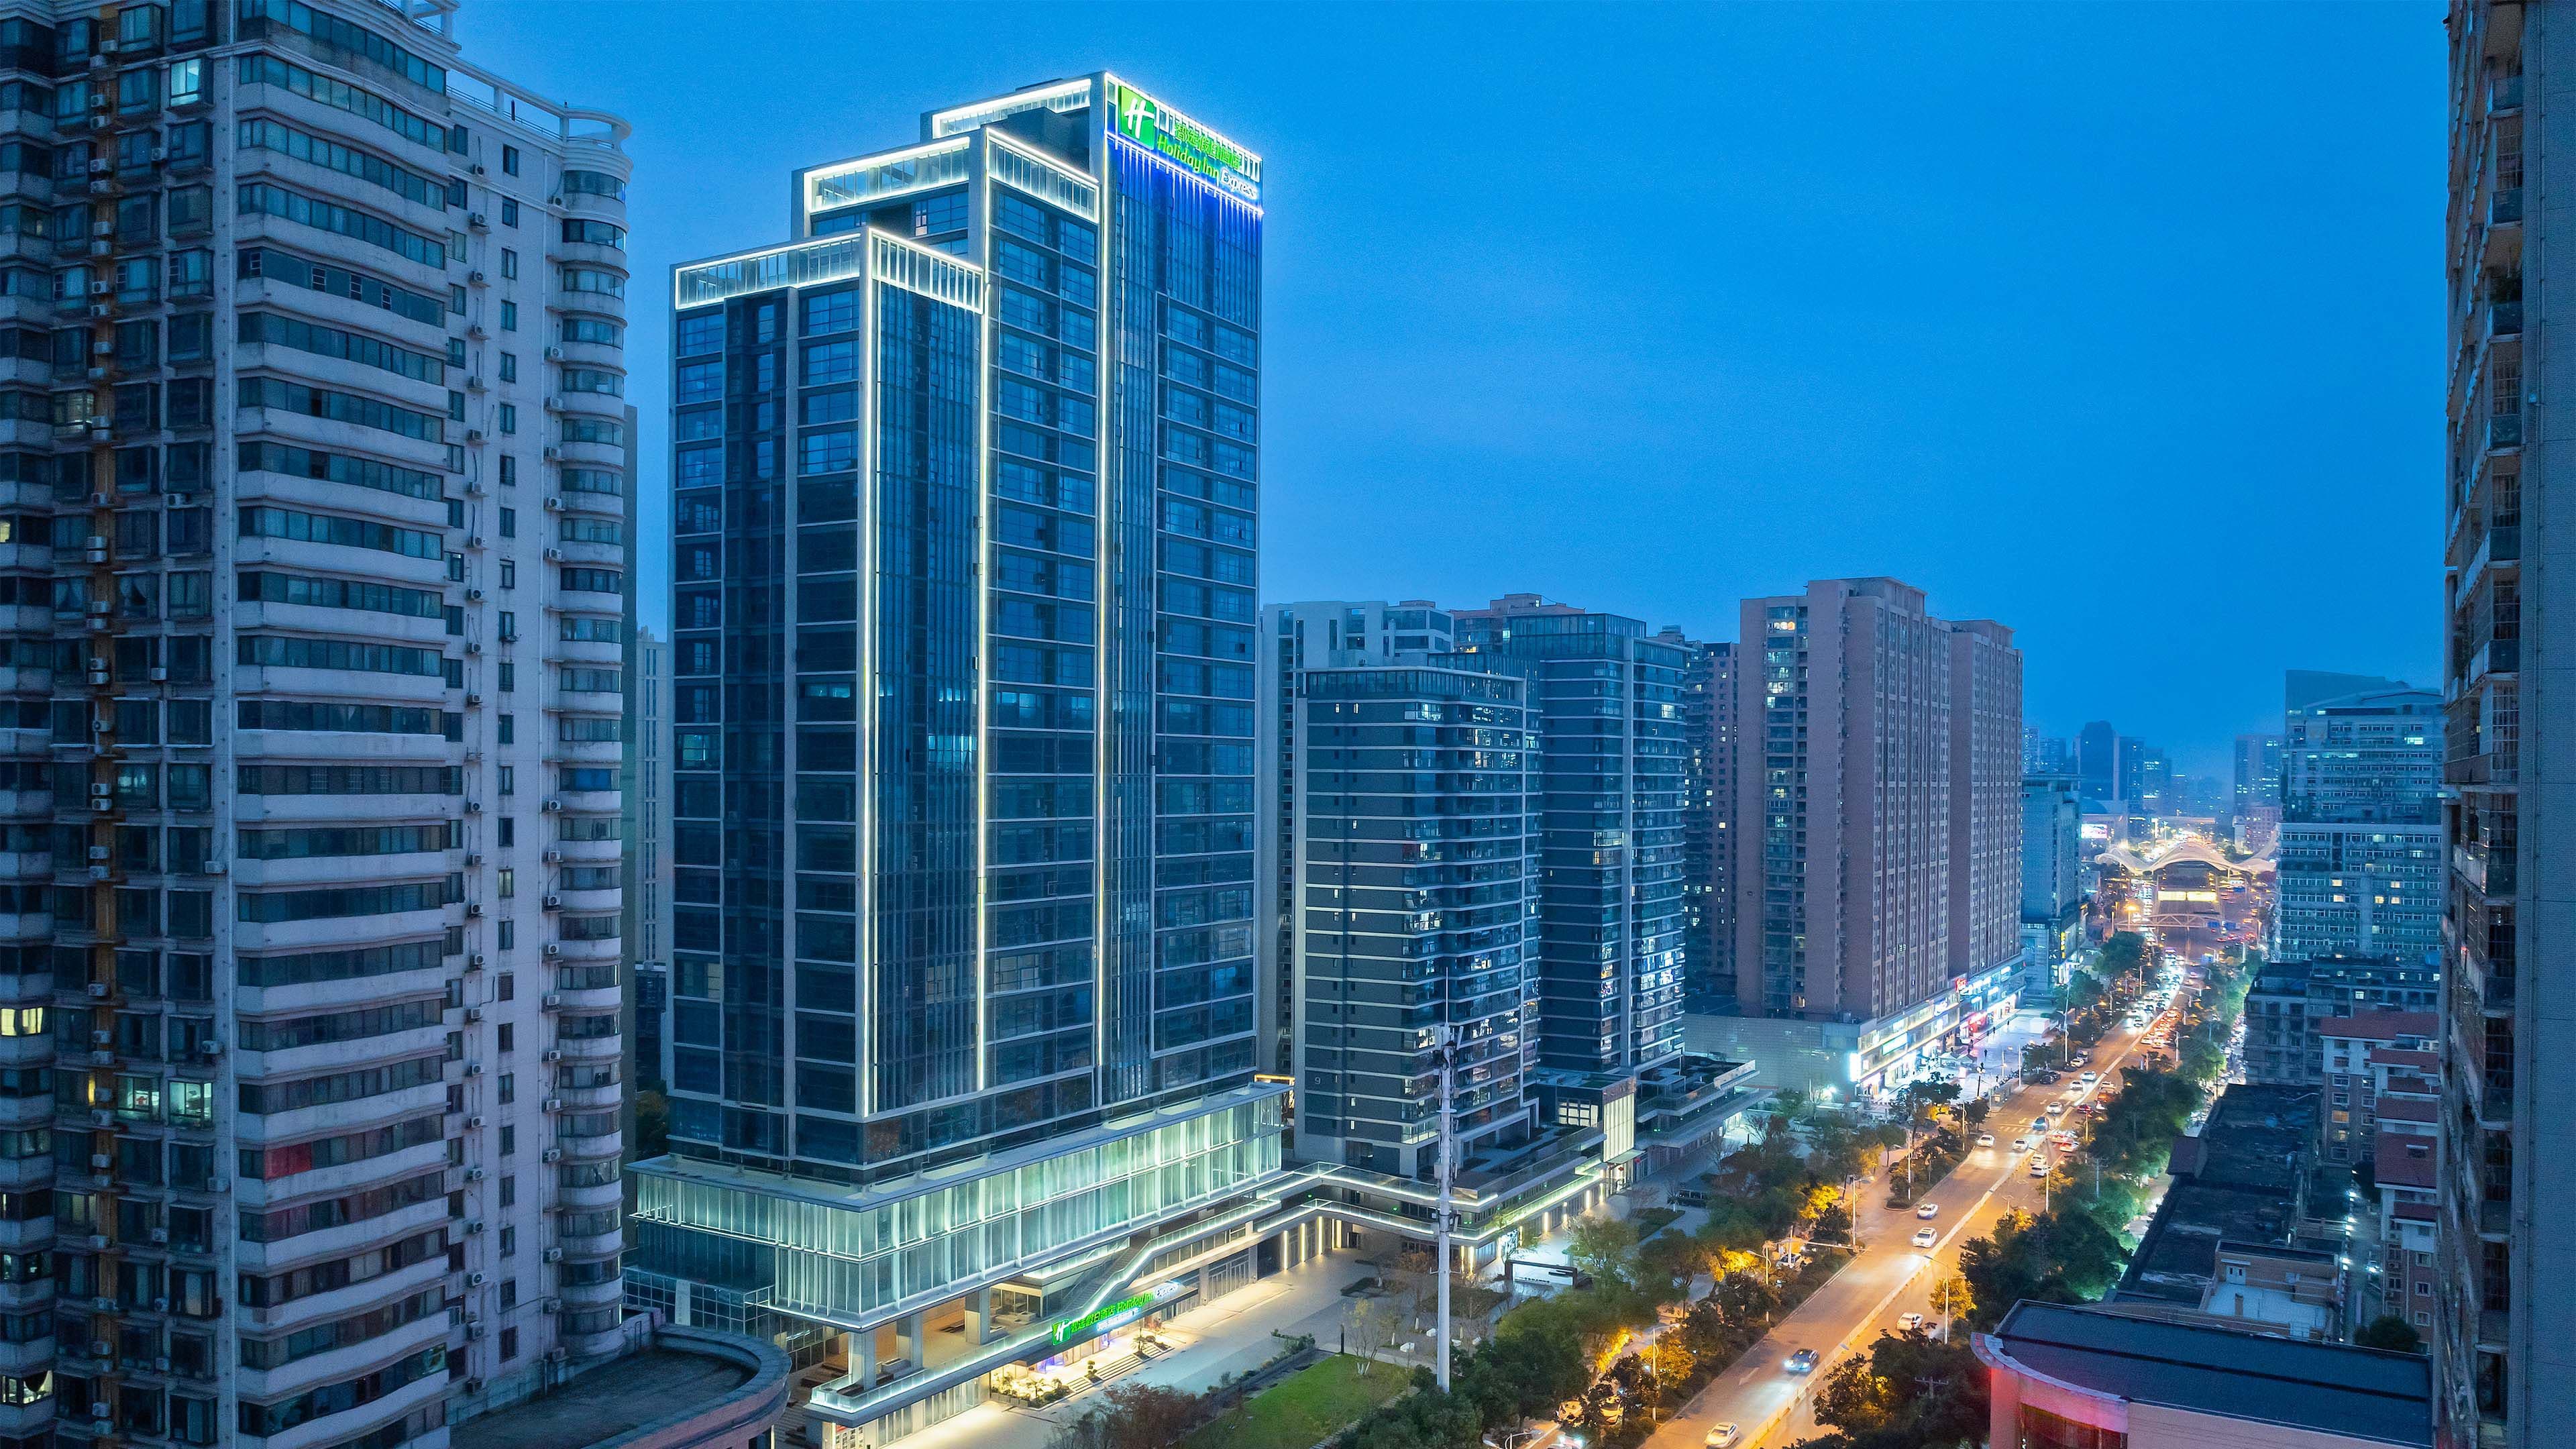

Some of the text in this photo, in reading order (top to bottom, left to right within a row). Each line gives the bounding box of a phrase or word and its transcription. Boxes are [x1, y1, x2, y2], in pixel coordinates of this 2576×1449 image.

[1175, 122, 1241, 170] 智选假日酒店
[1157, 133, 1257, 200] Holiday Inn Express
[1314, 1076, 1321, 1085] 9
[1117, 1297, 1142, 1313] Holiday
[1142, 1292, 1154, 1305] Inn
